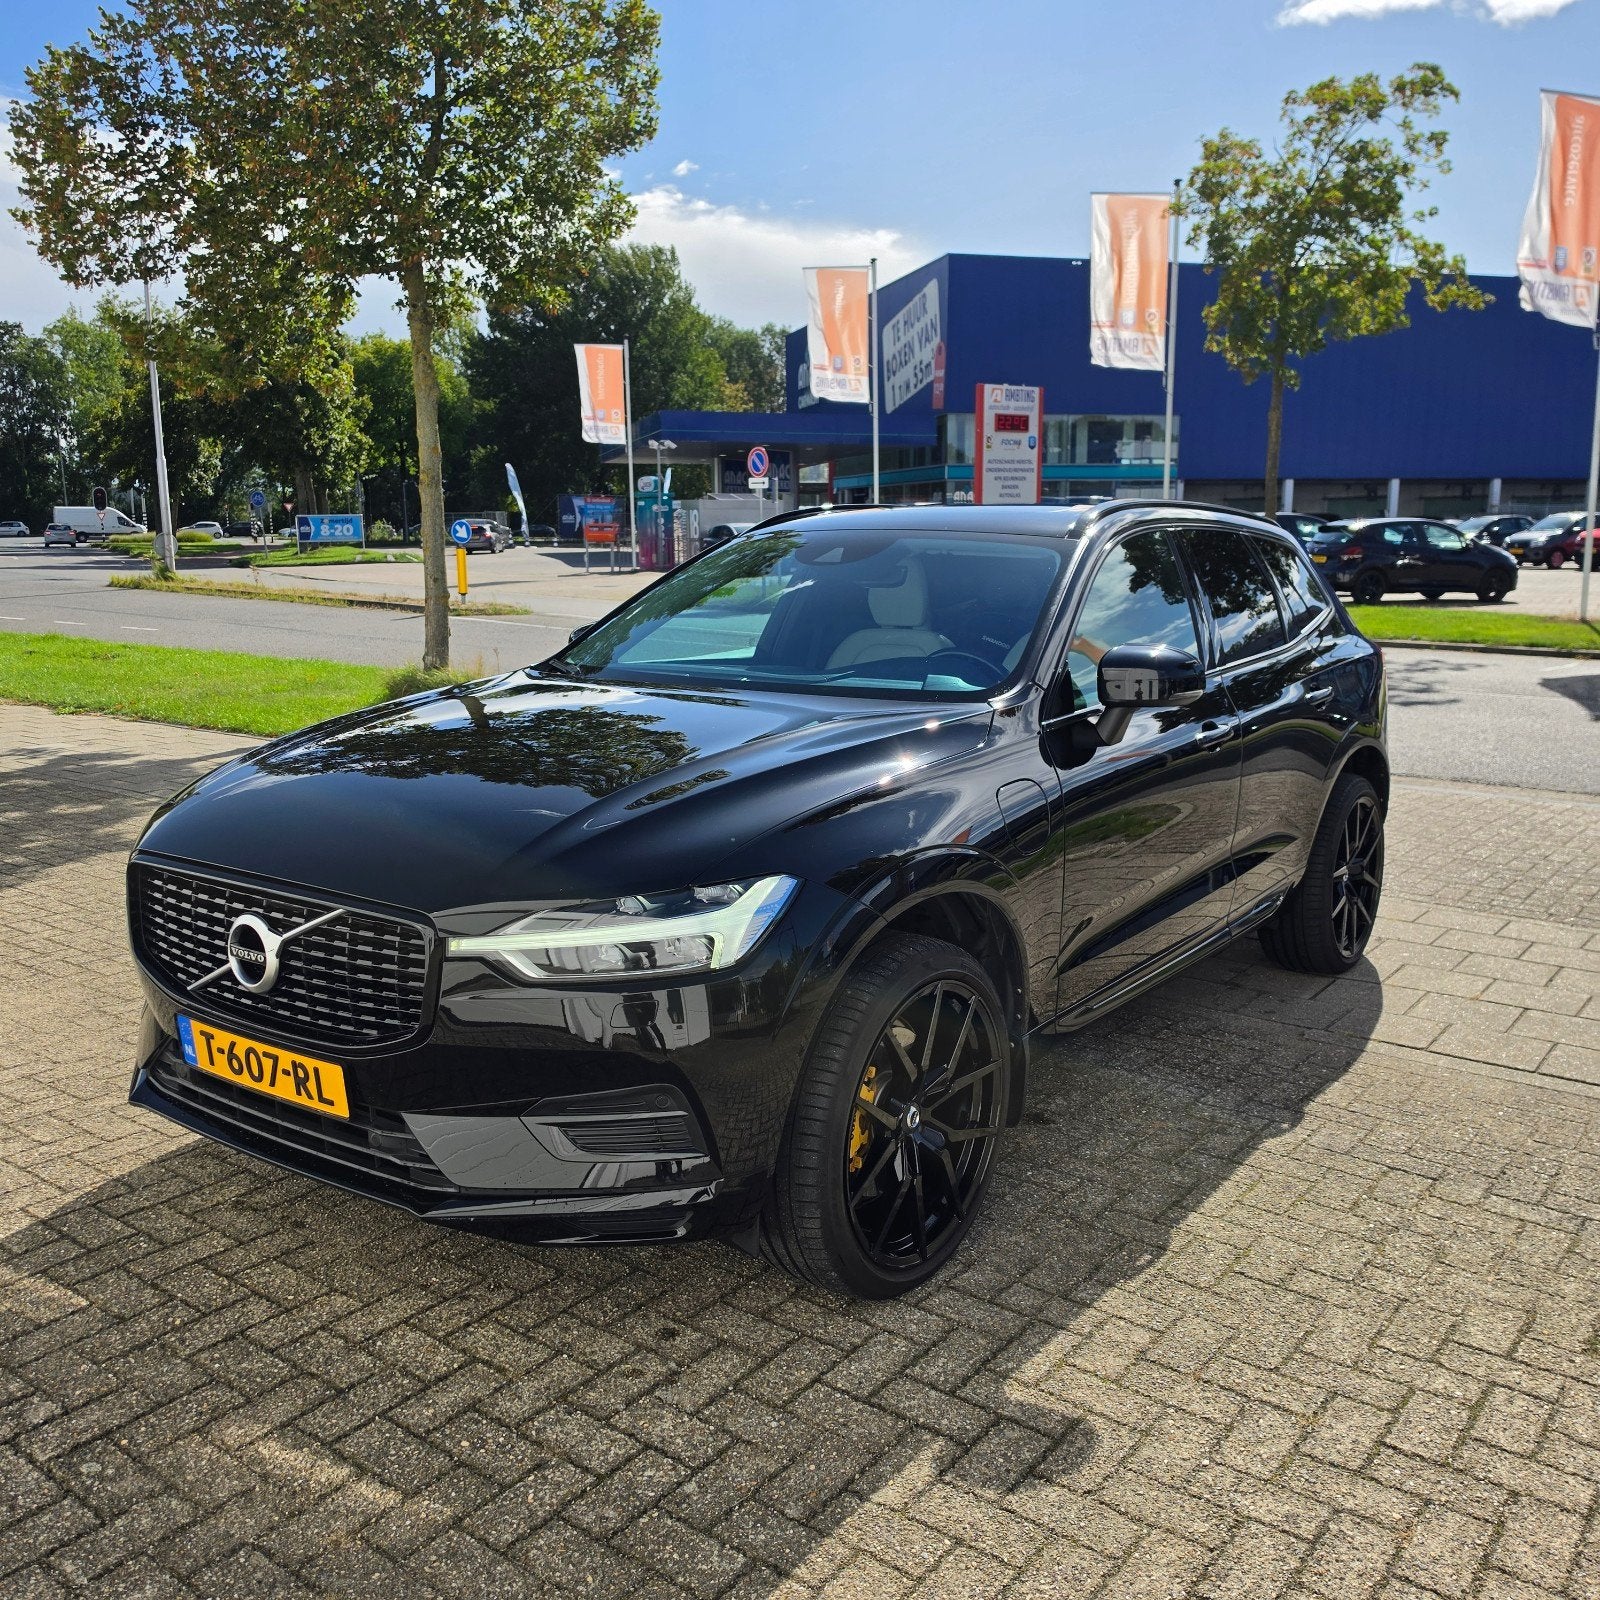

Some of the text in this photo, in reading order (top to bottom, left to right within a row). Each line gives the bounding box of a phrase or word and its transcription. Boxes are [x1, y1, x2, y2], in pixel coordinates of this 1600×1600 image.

[892, 292, 928, 346] TE HUUR
[886, 313, 938, 383] BOXEN VAN
[1005, 388, 1036, 403] AMBTING
[320, 524, 354, 536] 8-20
[231, 946, 264, 962] VOLVO
[185, 1043, 196, 1057] NL
[199, 1029, 335, 1107] T-607-RL
